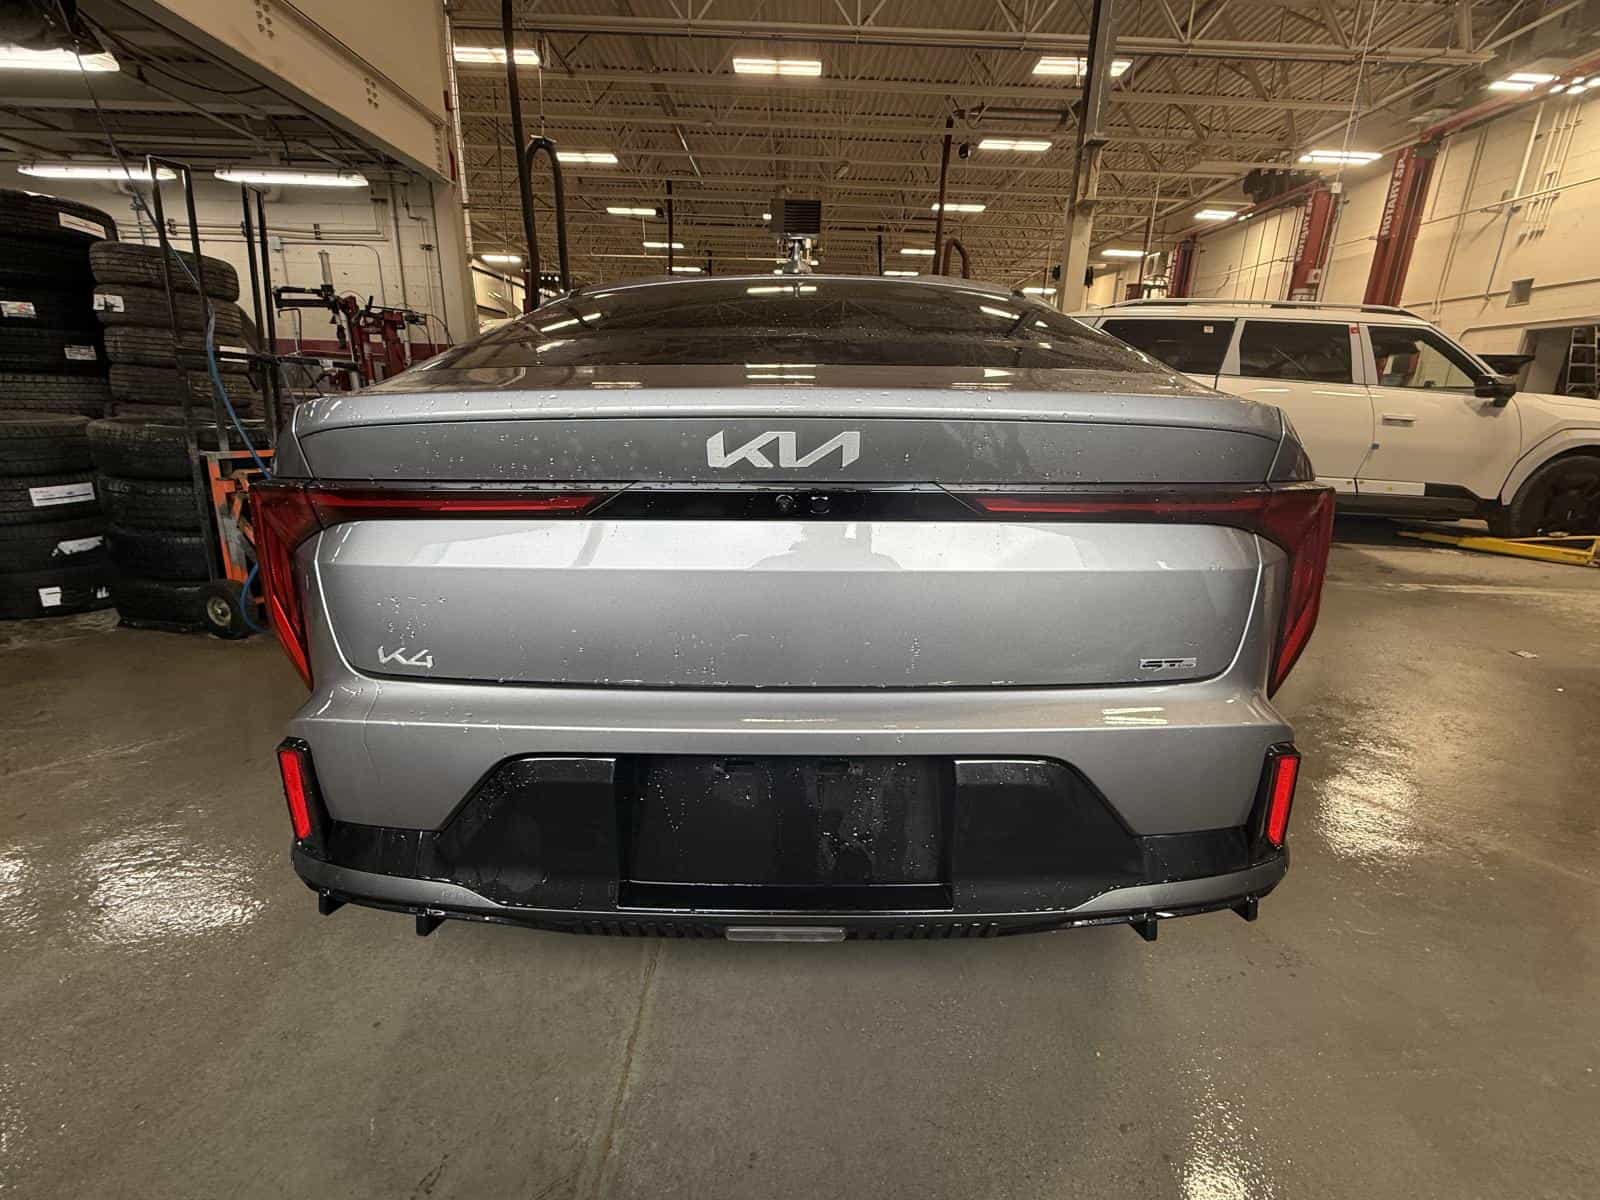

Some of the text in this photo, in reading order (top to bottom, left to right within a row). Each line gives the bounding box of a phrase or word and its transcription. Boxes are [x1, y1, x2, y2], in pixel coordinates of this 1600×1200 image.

[1381, 181, 1401, 239] ROTARY
[706, 431, 861, 468] KIA
[377, 645, 434, 668] K4
